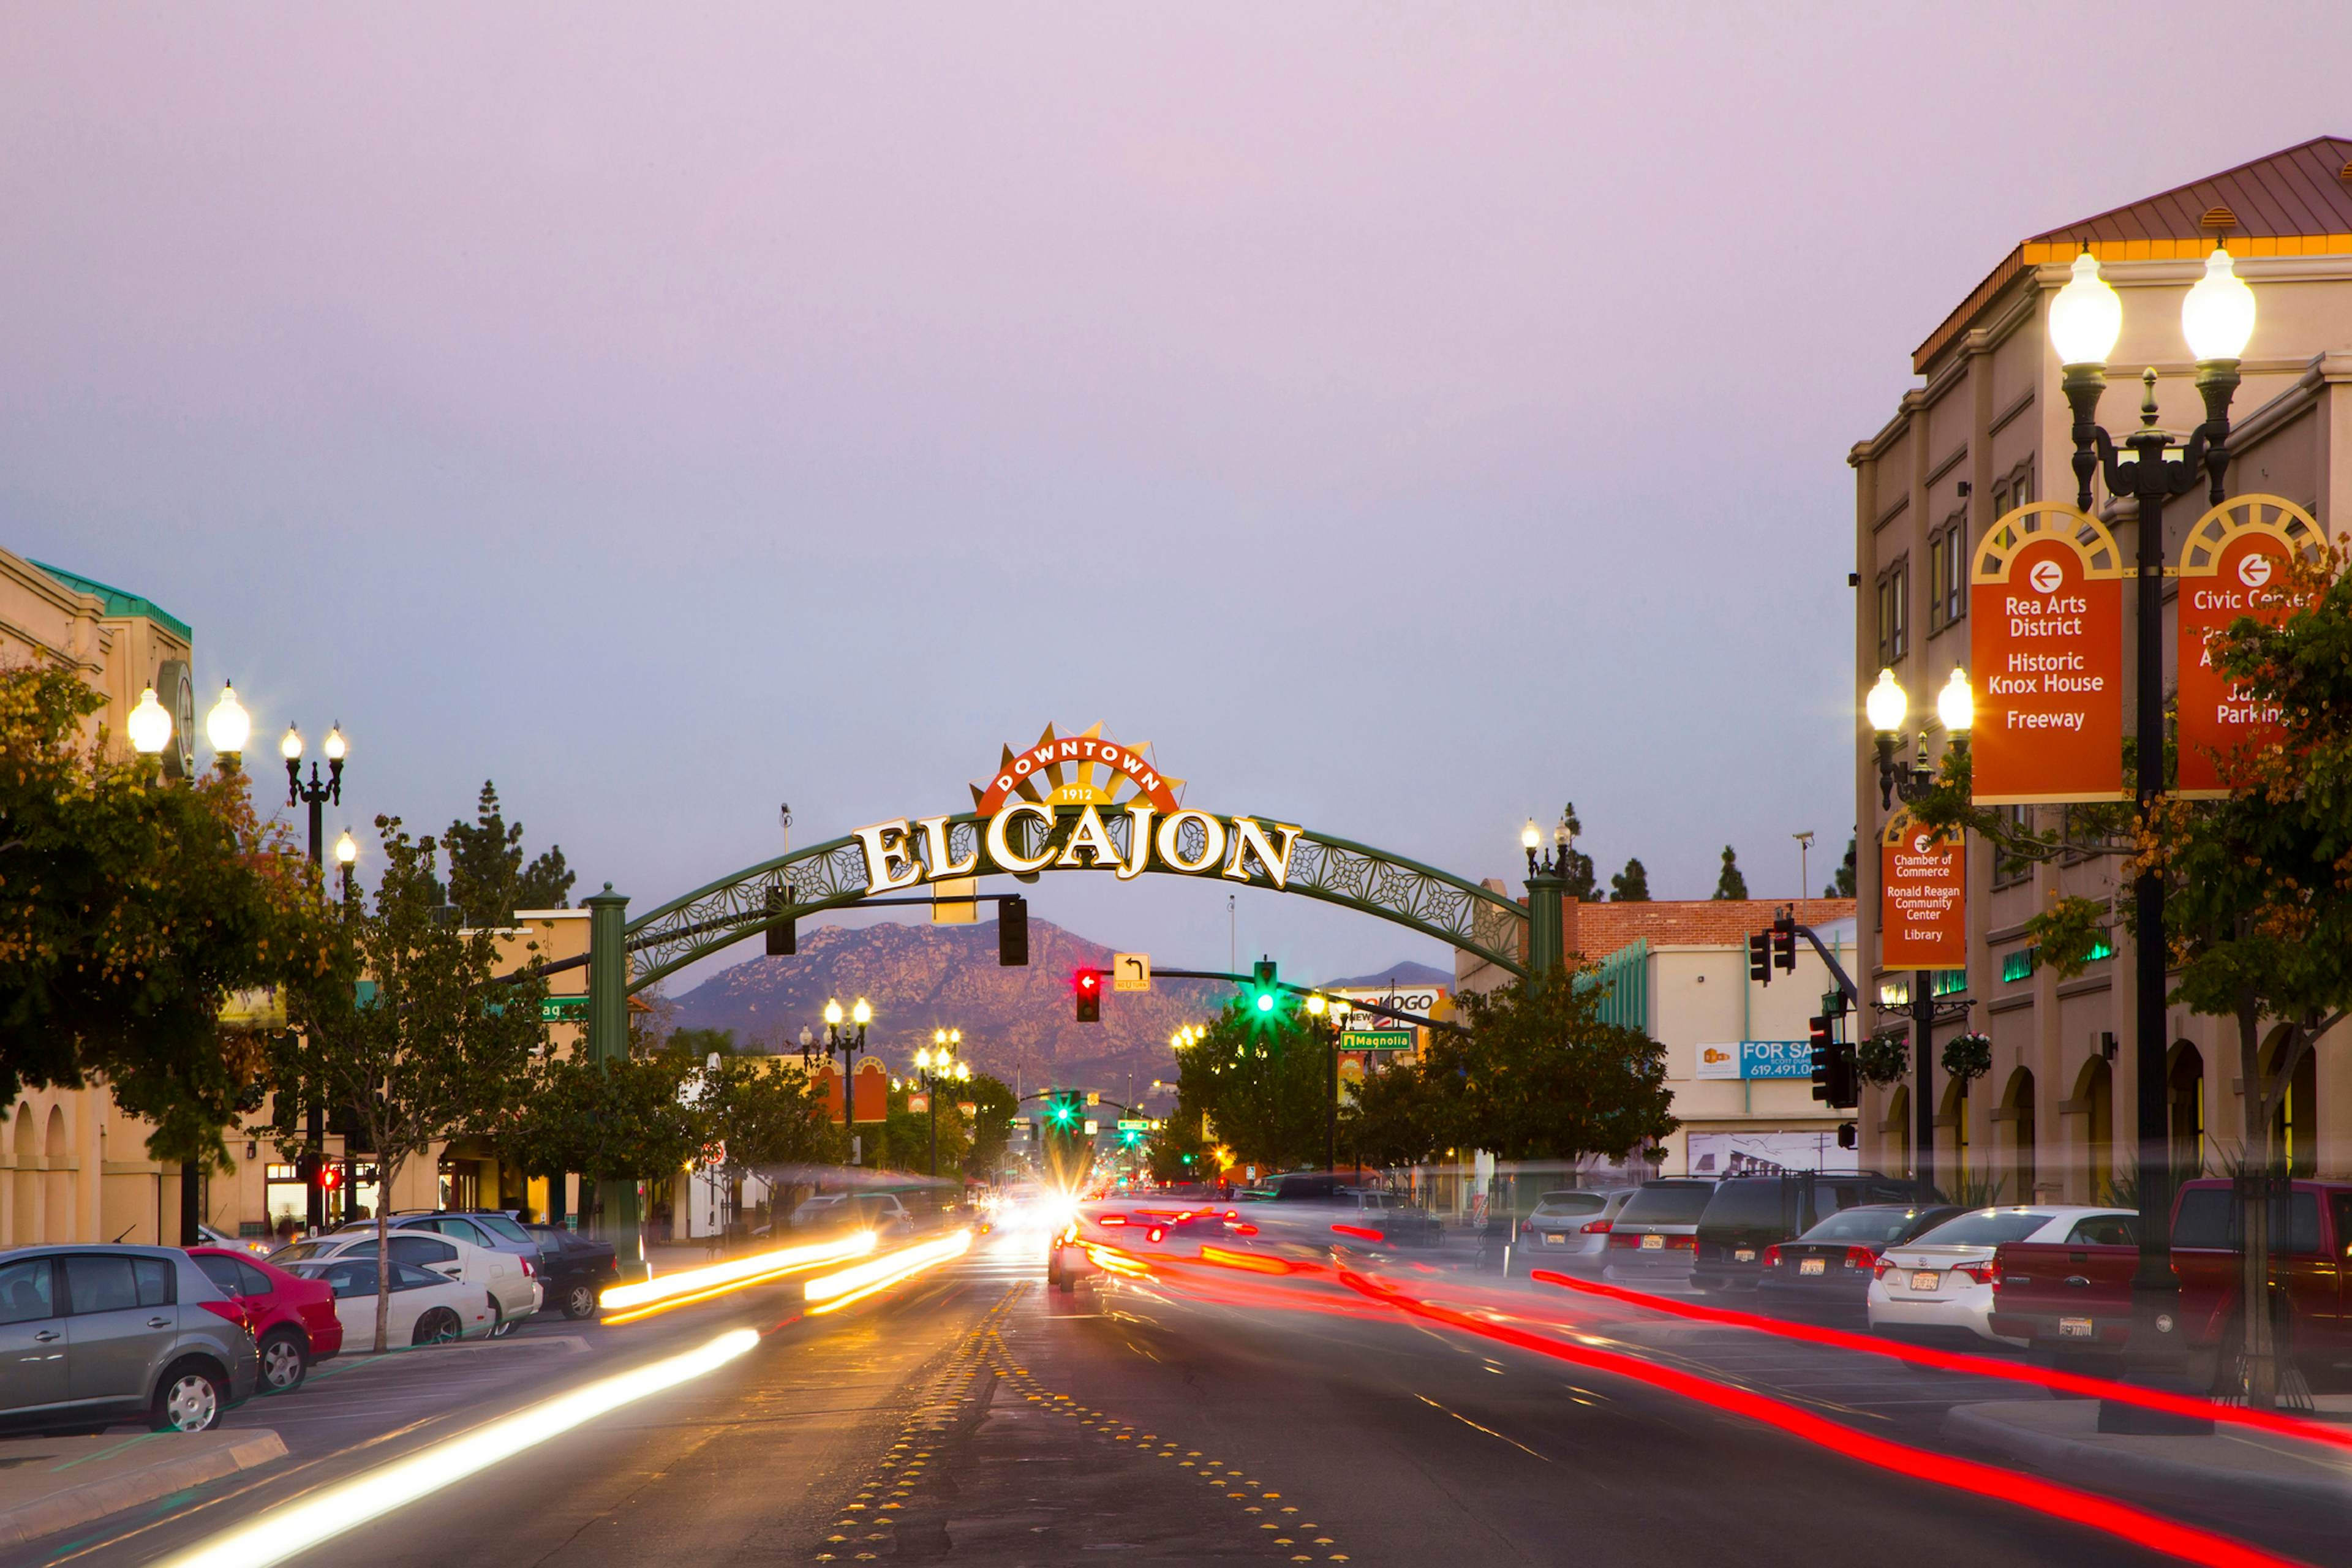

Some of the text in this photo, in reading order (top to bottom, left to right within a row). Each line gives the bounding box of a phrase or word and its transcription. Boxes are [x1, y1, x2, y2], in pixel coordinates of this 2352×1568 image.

[2006, 595, 2087, 616] Rea Arts
[2193, 590, 2241, 609] Civic
[2010, 617, 2082, 637] District
[2008, 652, 2084, 672] Historic
[1989, 674, 2104, 694] Knox House
[2007, 710, 2084, 731] Freeway
[996, 741, 1160, 792] DOWNTOWN
[1062, 788, 1092, 800] 1912
[853, 802, 1305, 896] EL CAJON
[1894, 854, 1953, 865] Chamber of
[1896, 866, 1950, 877] Commerce
[1888, 886, 1960, 899] Ronald Reagan
[1895, 898, 1953, 910] Community
[1906, 910, 1941, 920] Center
[1905, 929, 1943, 942] Library
[1356, 1036, 1408, 1048] Magnolia
[1744, 1043, 1784, 1058] FOR
[1789, 1042, 1819, 1058] SA
